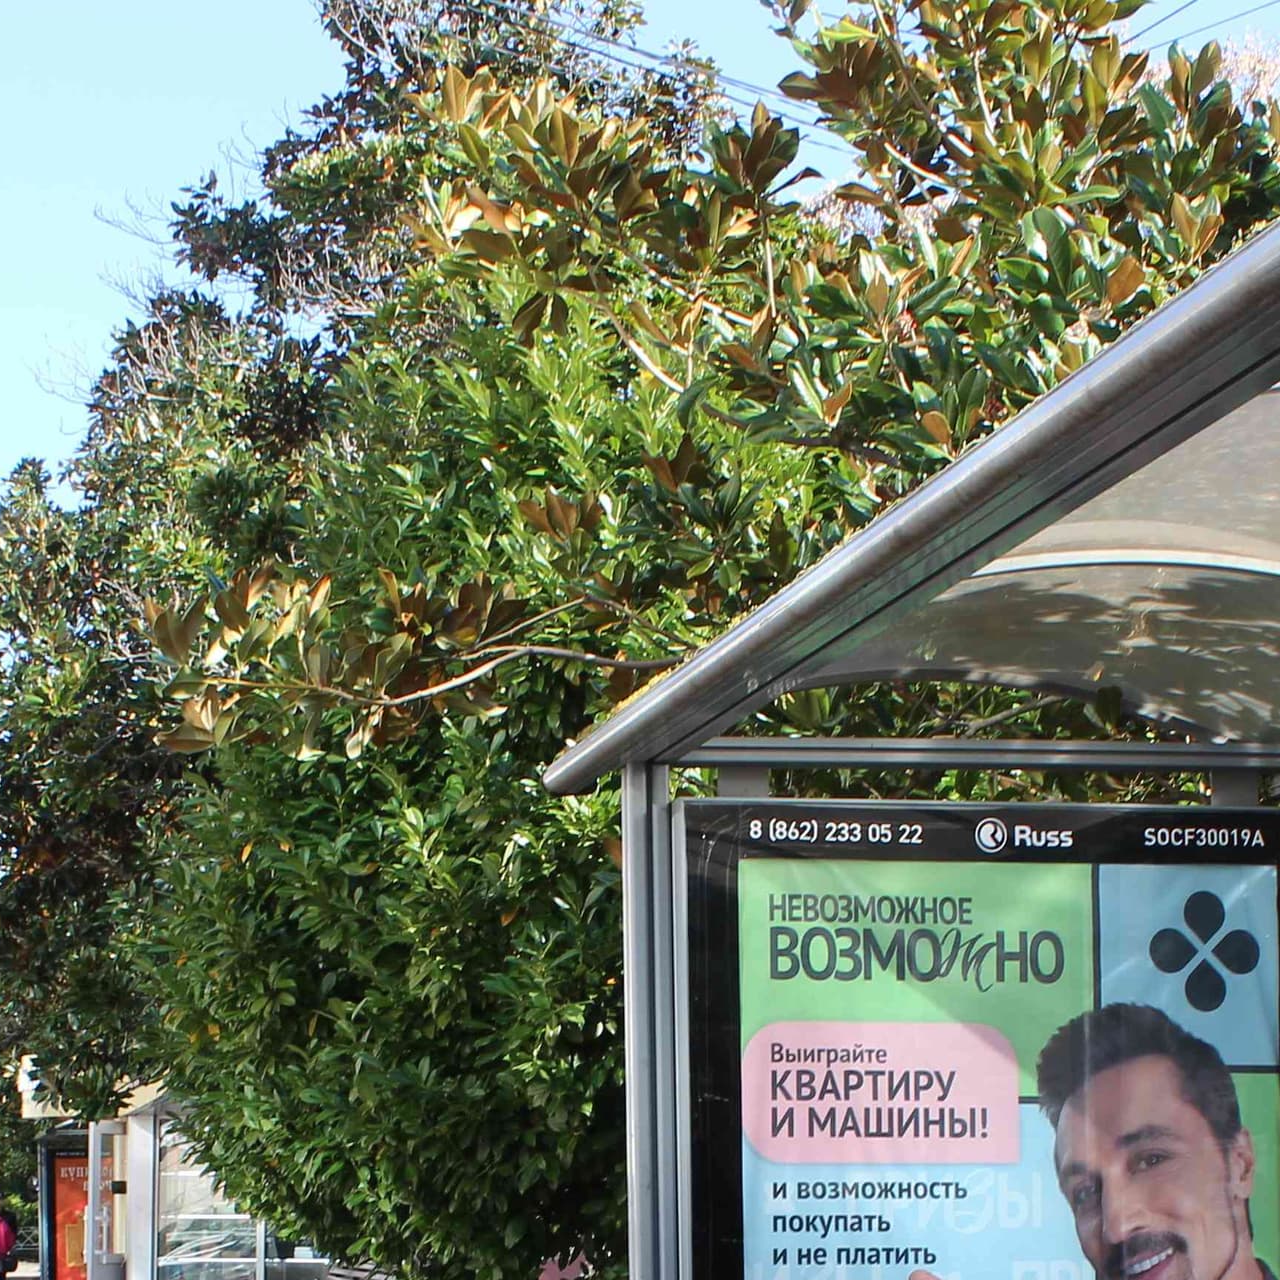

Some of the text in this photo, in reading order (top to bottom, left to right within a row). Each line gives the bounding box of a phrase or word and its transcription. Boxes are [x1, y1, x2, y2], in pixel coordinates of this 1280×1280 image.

[749, 818, 923, 844] 8 (862) 233 05 22
[1014, 825, 1074, 848] Russ
[1144, 827, 1265, 848] SOCF30019A
[768, 893, 973, 926] НЕВОЗМОЖНОЕ
[768, 926, 1065, 993] ВОЗМОЖНО
[770, 1041, 888, 1067] Выиграйте
[770, 1069, 957, 1102] КВАРТИРУ
[770, 1106, 990, 1140] И МАШИНЫ!
[772, 1181, 968, 1201] и возможность
[772, 1214, 891, 1237] покупать
[772, 1246, 937, 1267] и не платить
